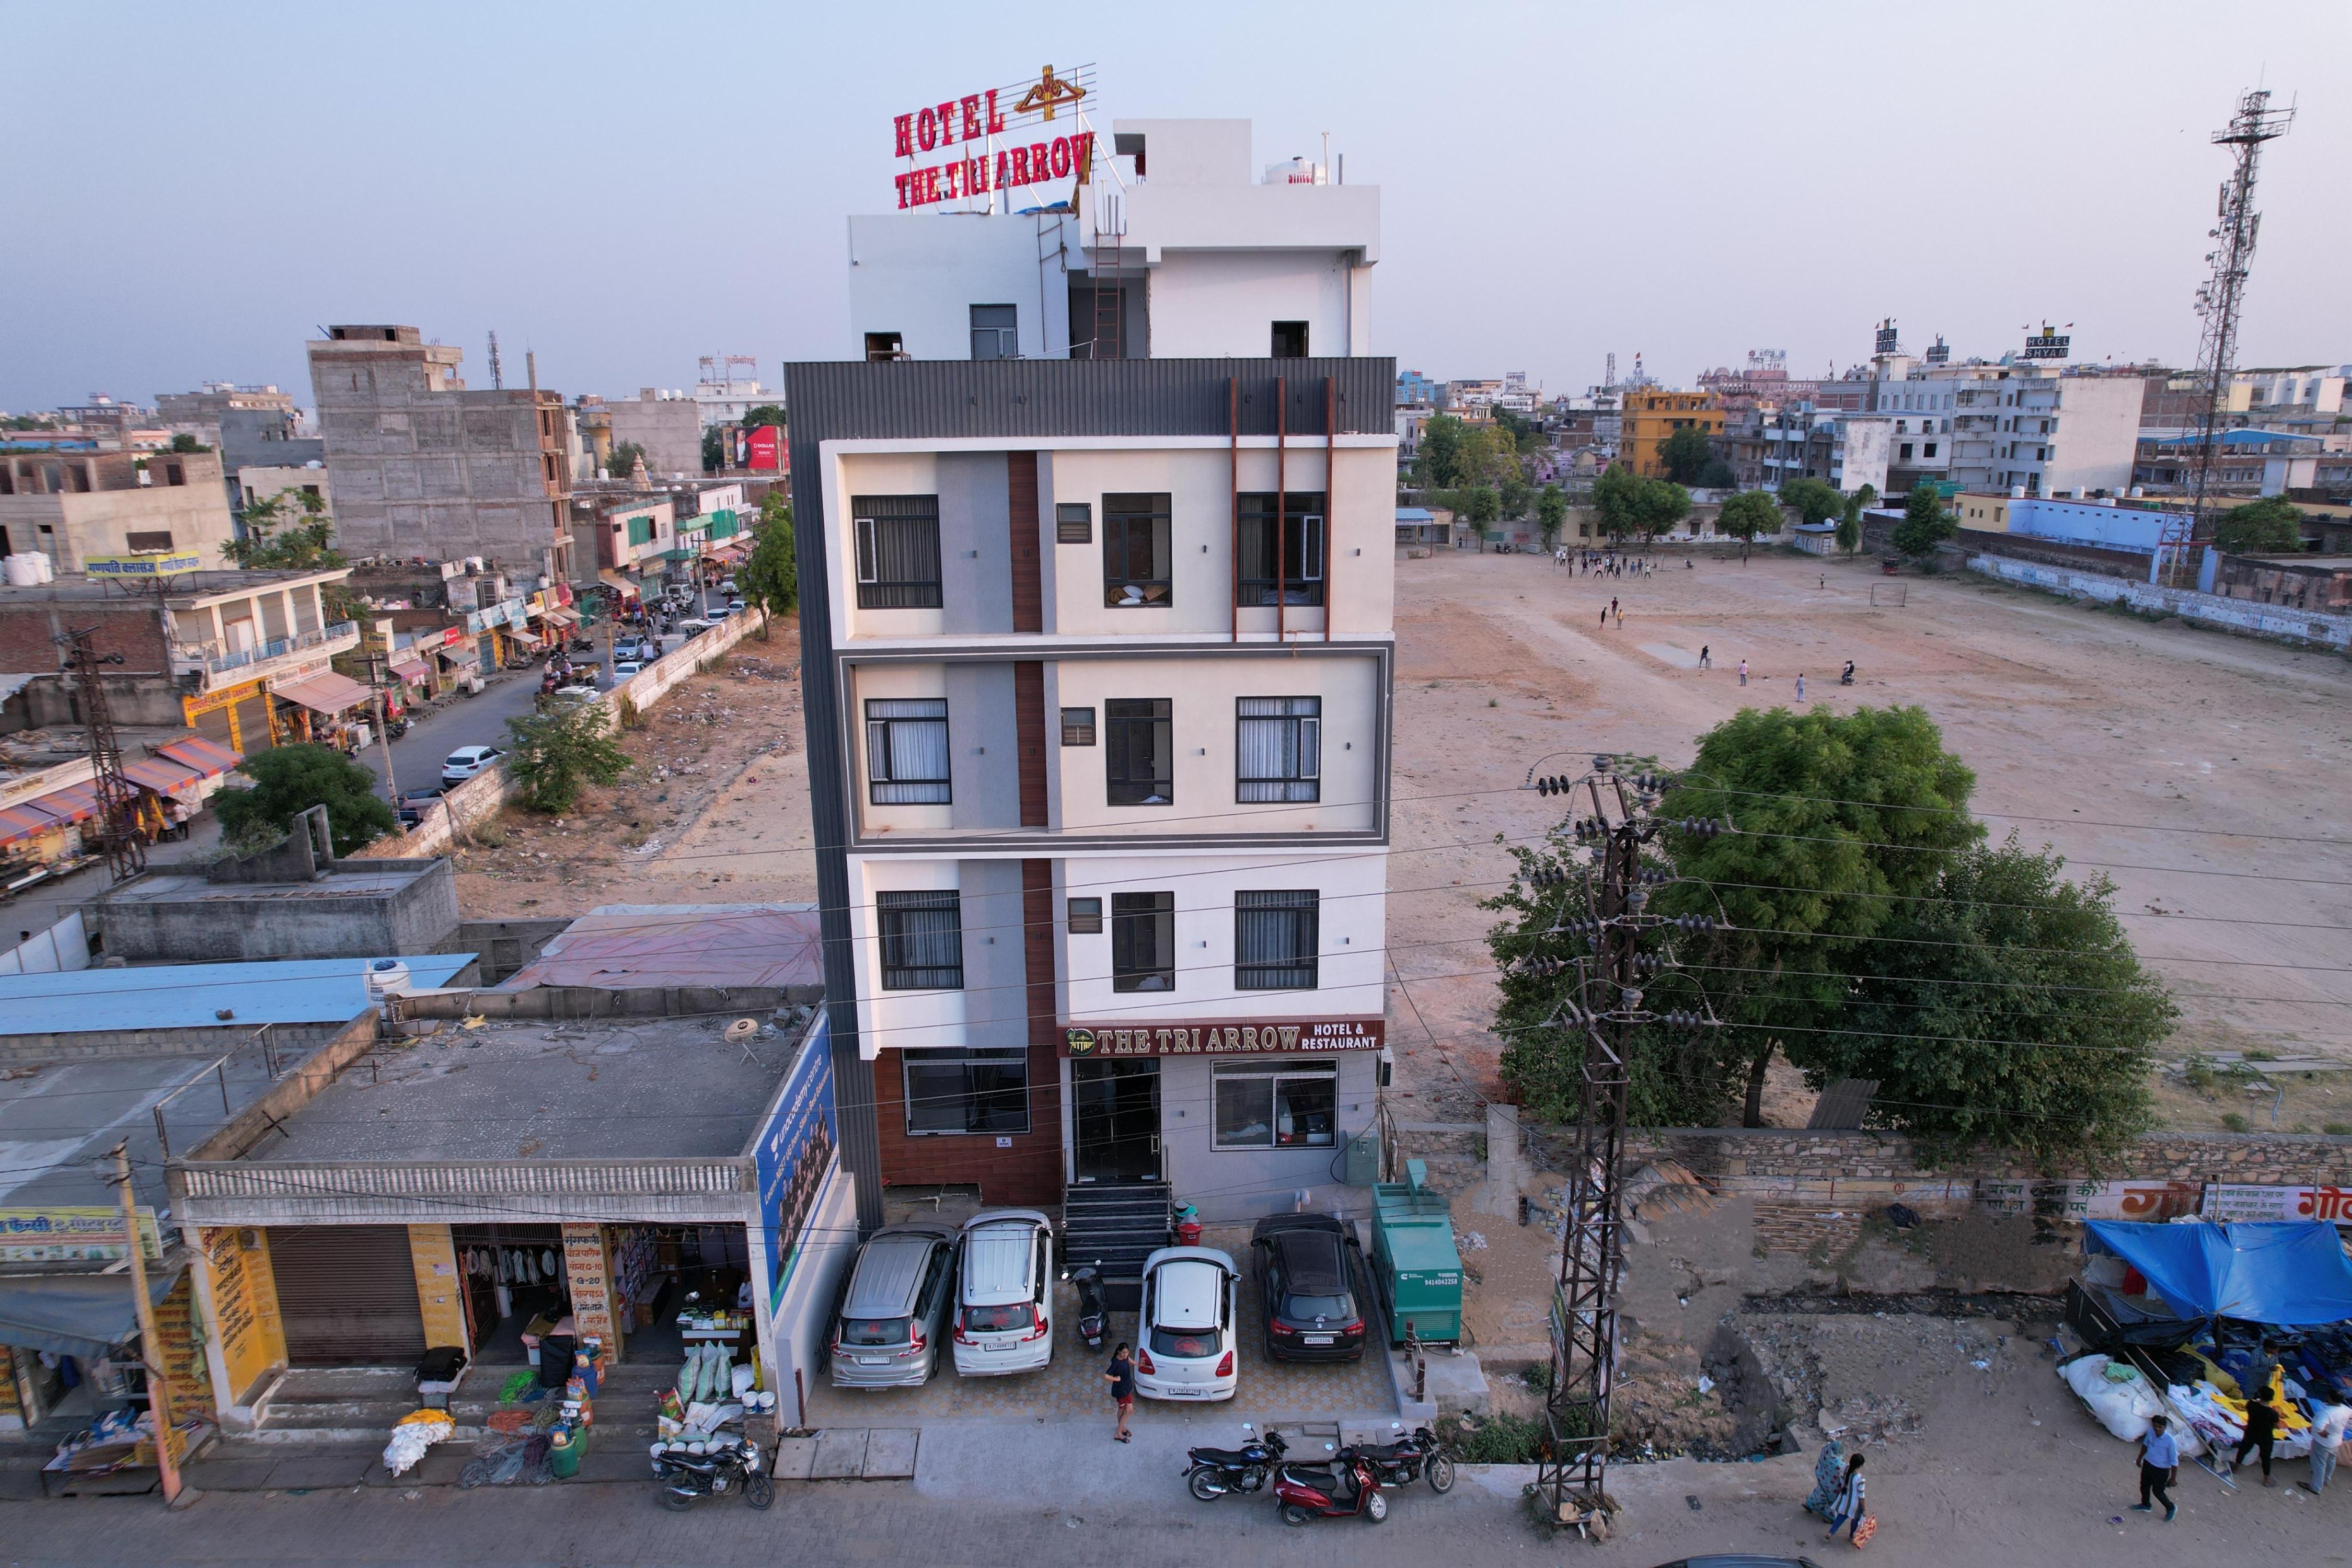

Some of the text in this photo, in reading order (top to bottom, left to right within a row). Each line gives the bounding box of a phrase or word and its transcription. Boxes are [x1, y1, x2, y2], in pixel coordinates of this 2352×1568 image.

[894, 89, 1005, 157] HOTEL
[895, 132, 1095, 209] THE TRI ARROW
[1288, 174, 1313, 184] Sinte
[1876, 330, 1895, 340] HOTEL
[2028, 337, 2069, 346] HOTEL
[1875, 341, 1895, 352] SHYAM
[2025, 349, 2067, 358] SHYAM
[87, 560, 121, 573] गणपति
[1314, 1023, 1364, 1036] HOTEL &
[1097, 1026, 1300, 1054] THE TRI ARROW
[1301, 1036, 1377, 1050] RESTAURANT
[764, 1179, 777, 1206] Learn
[776, 1155, 787, 1180] NEET
